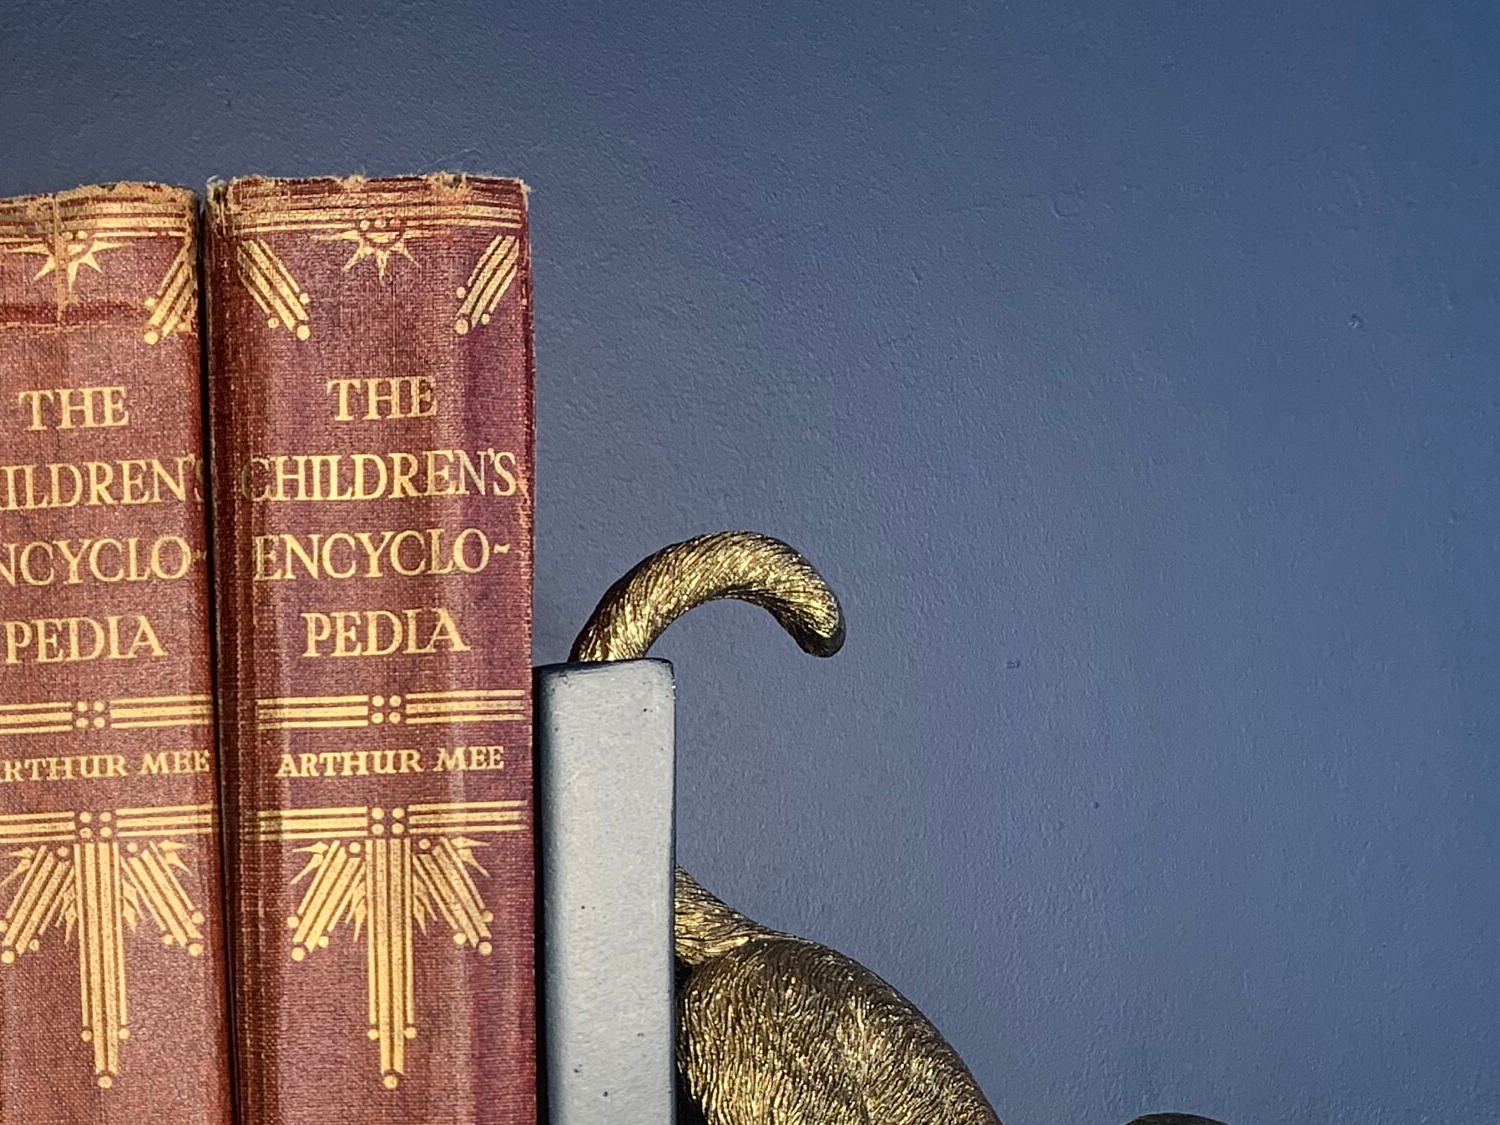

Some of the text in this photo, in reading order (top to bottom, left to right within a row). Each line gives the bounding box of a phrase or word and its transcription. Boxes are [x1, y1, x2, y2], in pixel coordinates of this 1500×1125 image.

[19, 385, 130, 431] THE
[326, 375, 438, 421] THE
[241, 447, 518, 501] CHILDREN'S
[253, 527, 511, 582] ENCYCLO-
[4, 614, 169, 665] PEDIA
[301, 607, 471, 657] PEDIA
[140, 749, 211, 775] MEE
[275, 745, 505, 778] ARTHUR MEE
